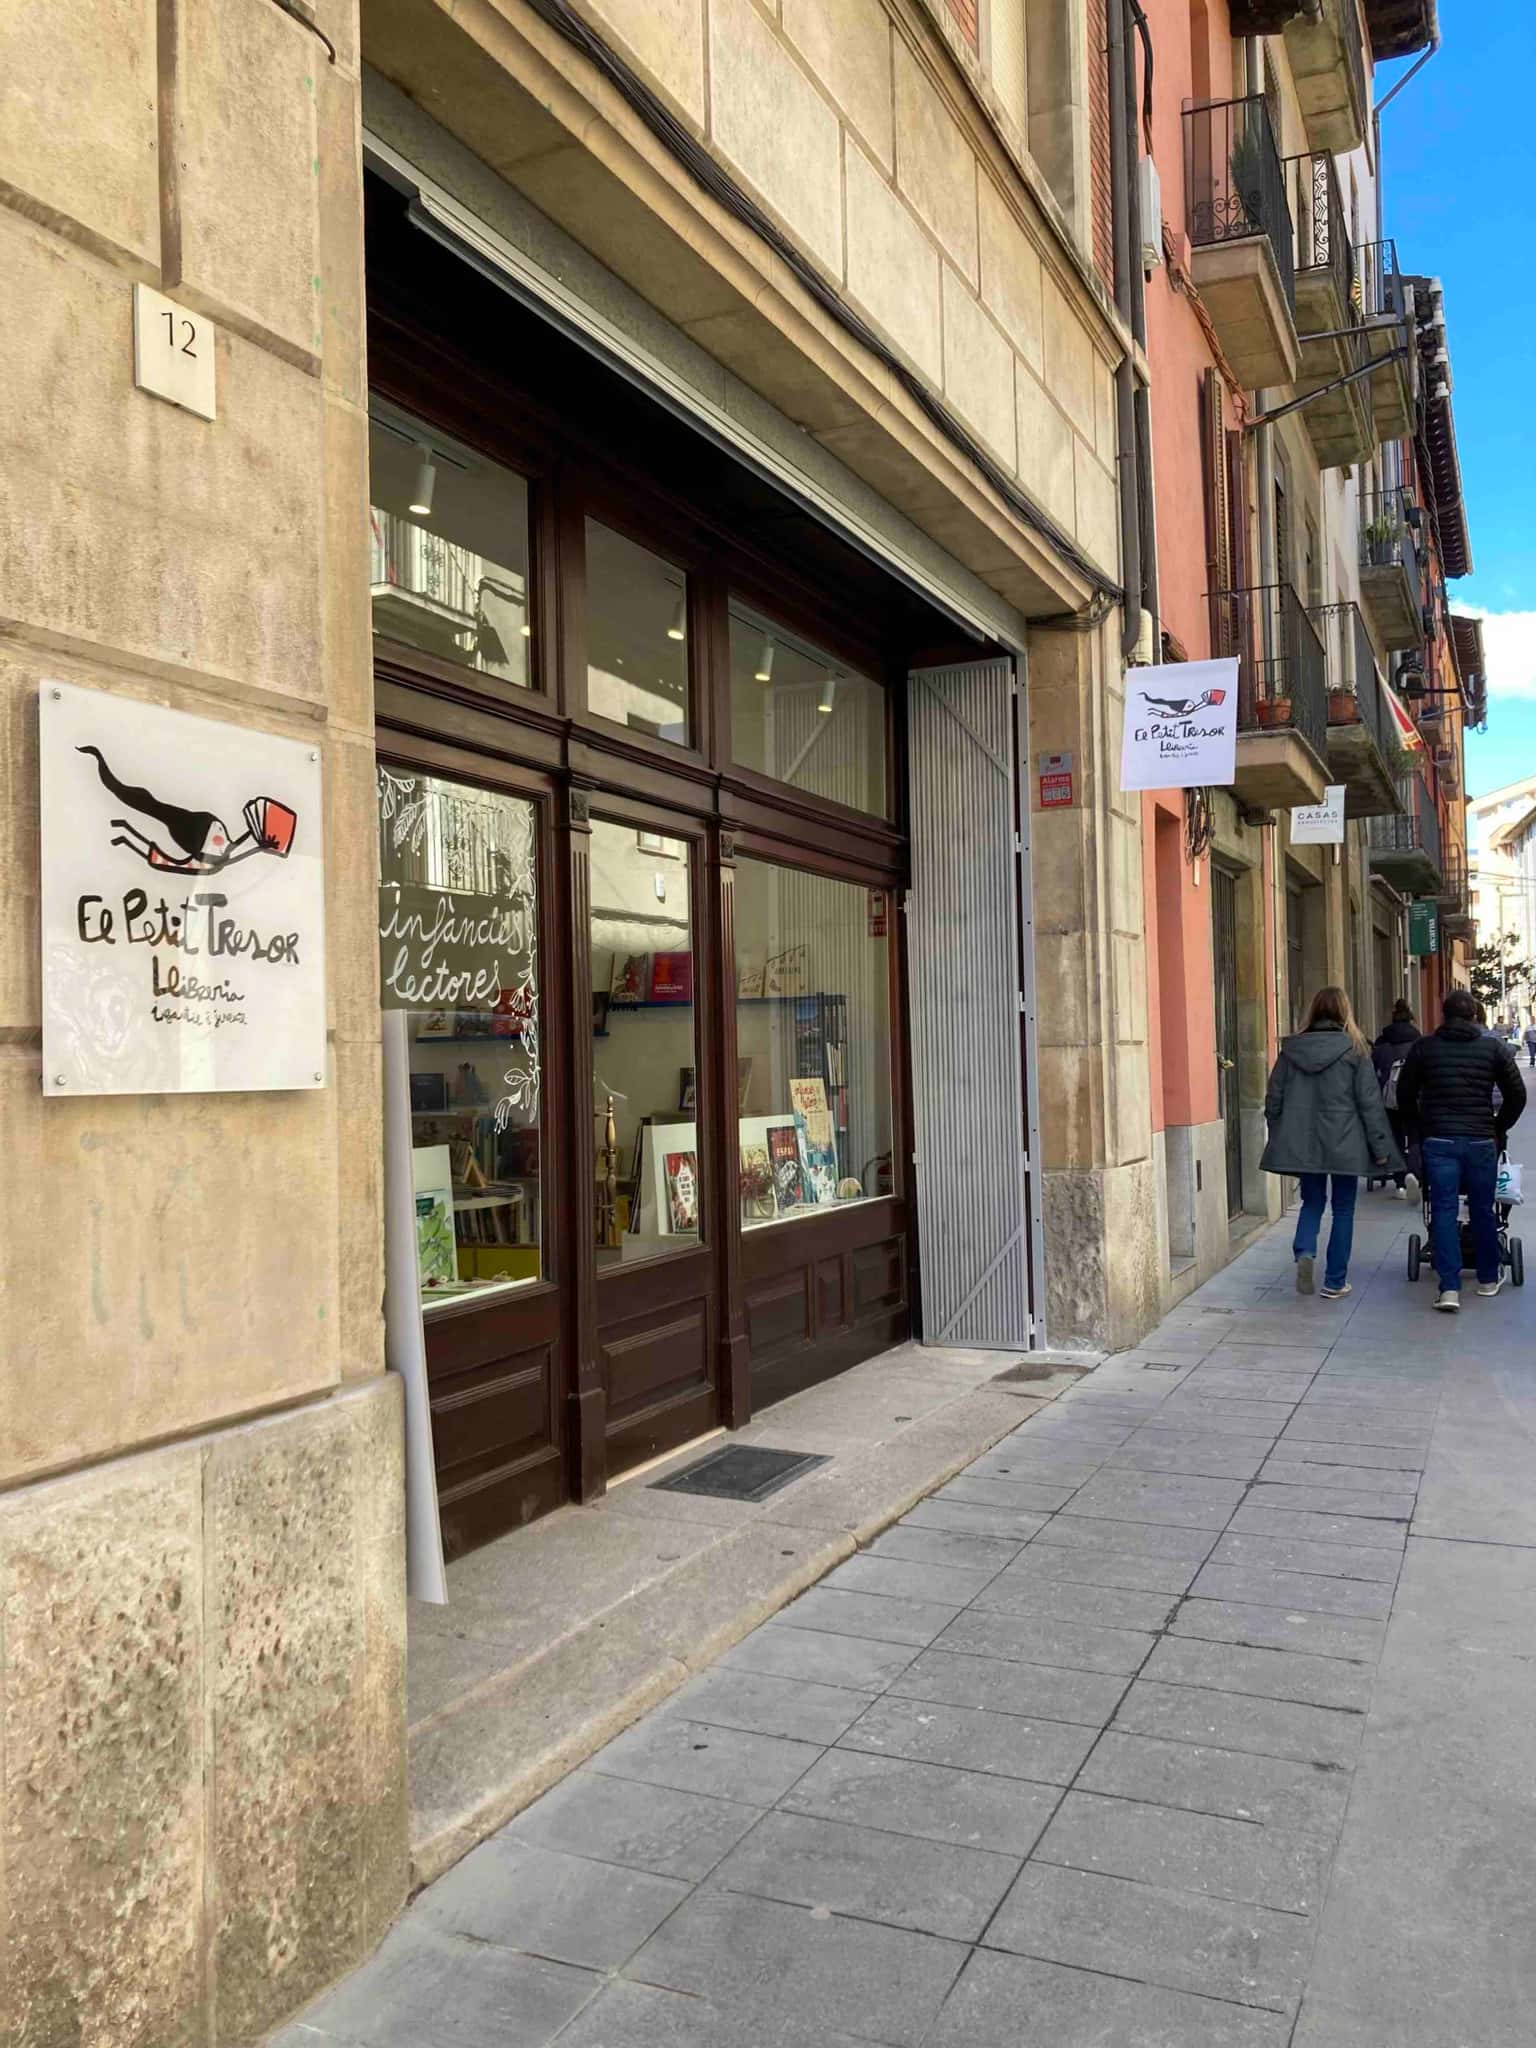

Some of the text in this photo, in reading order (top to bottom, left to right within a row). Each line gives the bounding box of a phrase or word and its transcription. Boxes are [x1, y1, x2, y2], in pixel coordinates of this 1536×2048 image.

[161, 312, 197, 358] 12
[1151, 723, 1180, 739] Petit
[1297, 811, 1338, 820] CASAS
[78, 894, 116, 945] El
[122, 890, 199, 955] Petit
[380, 890, 523, 969] infàncies
[386, 945, 501, 1008] lectores
